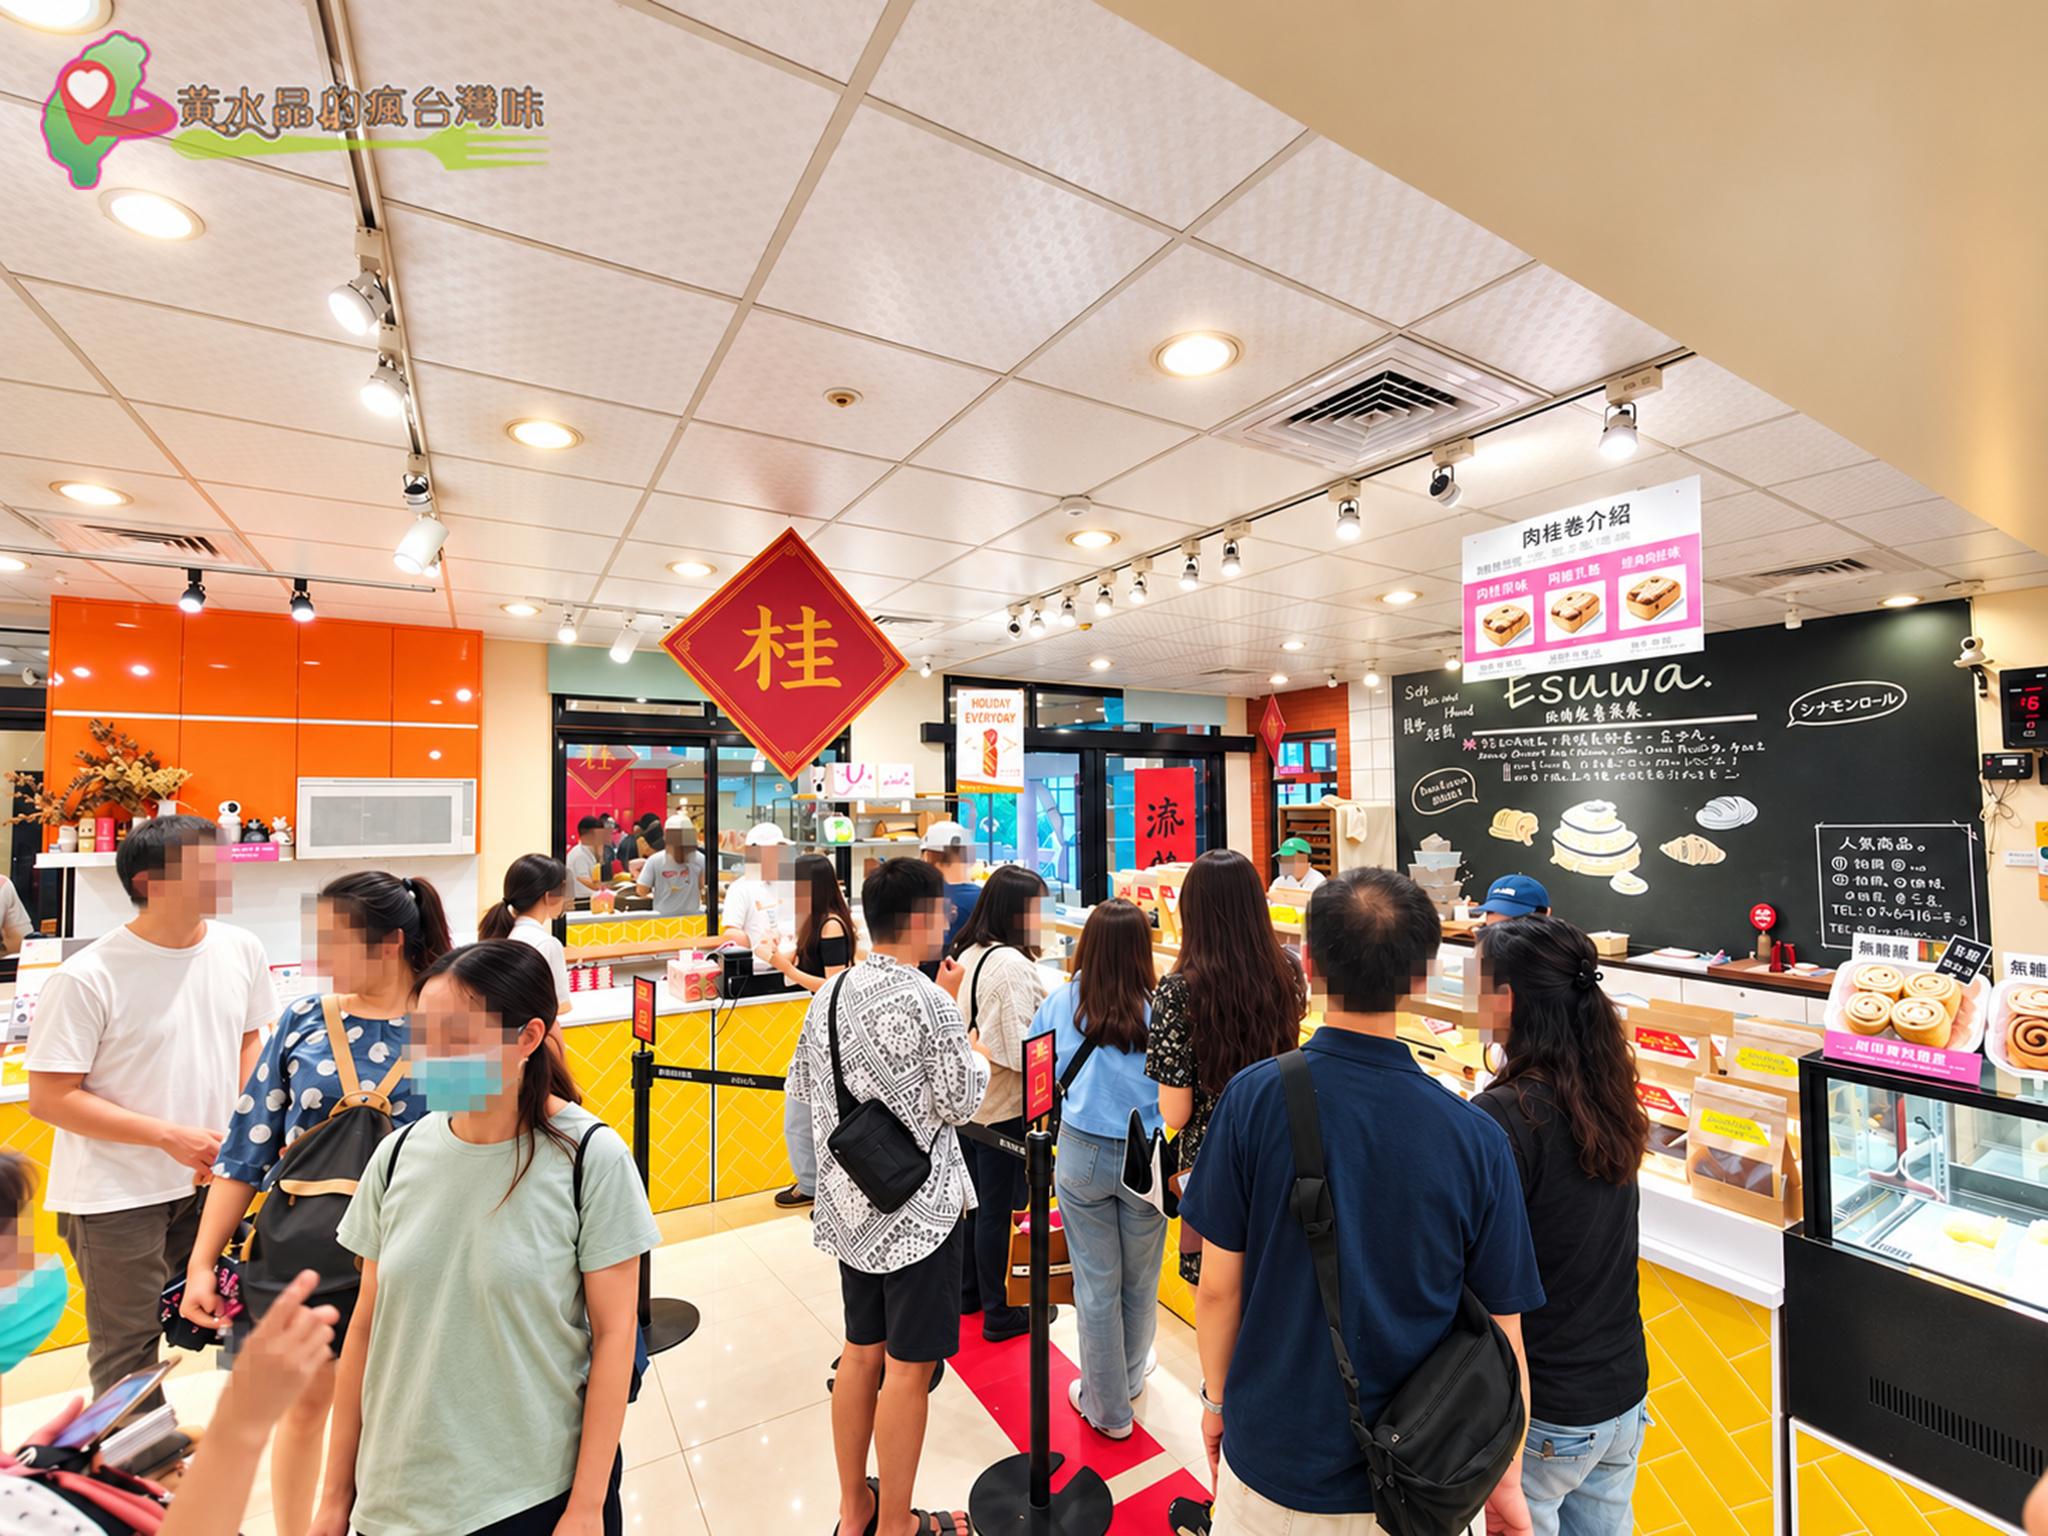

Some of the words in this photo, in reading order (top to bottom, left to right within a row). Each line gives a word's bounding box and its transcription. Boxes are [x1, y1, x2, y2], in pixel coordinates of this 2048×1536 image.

[734, 604, 843, 692] 桂
[971, 698, 1012, 709] HOLIDAY
[1799, 691, 1899, 718] シナモンロール
[964, 712, 1017, 724] EVERYDAY
